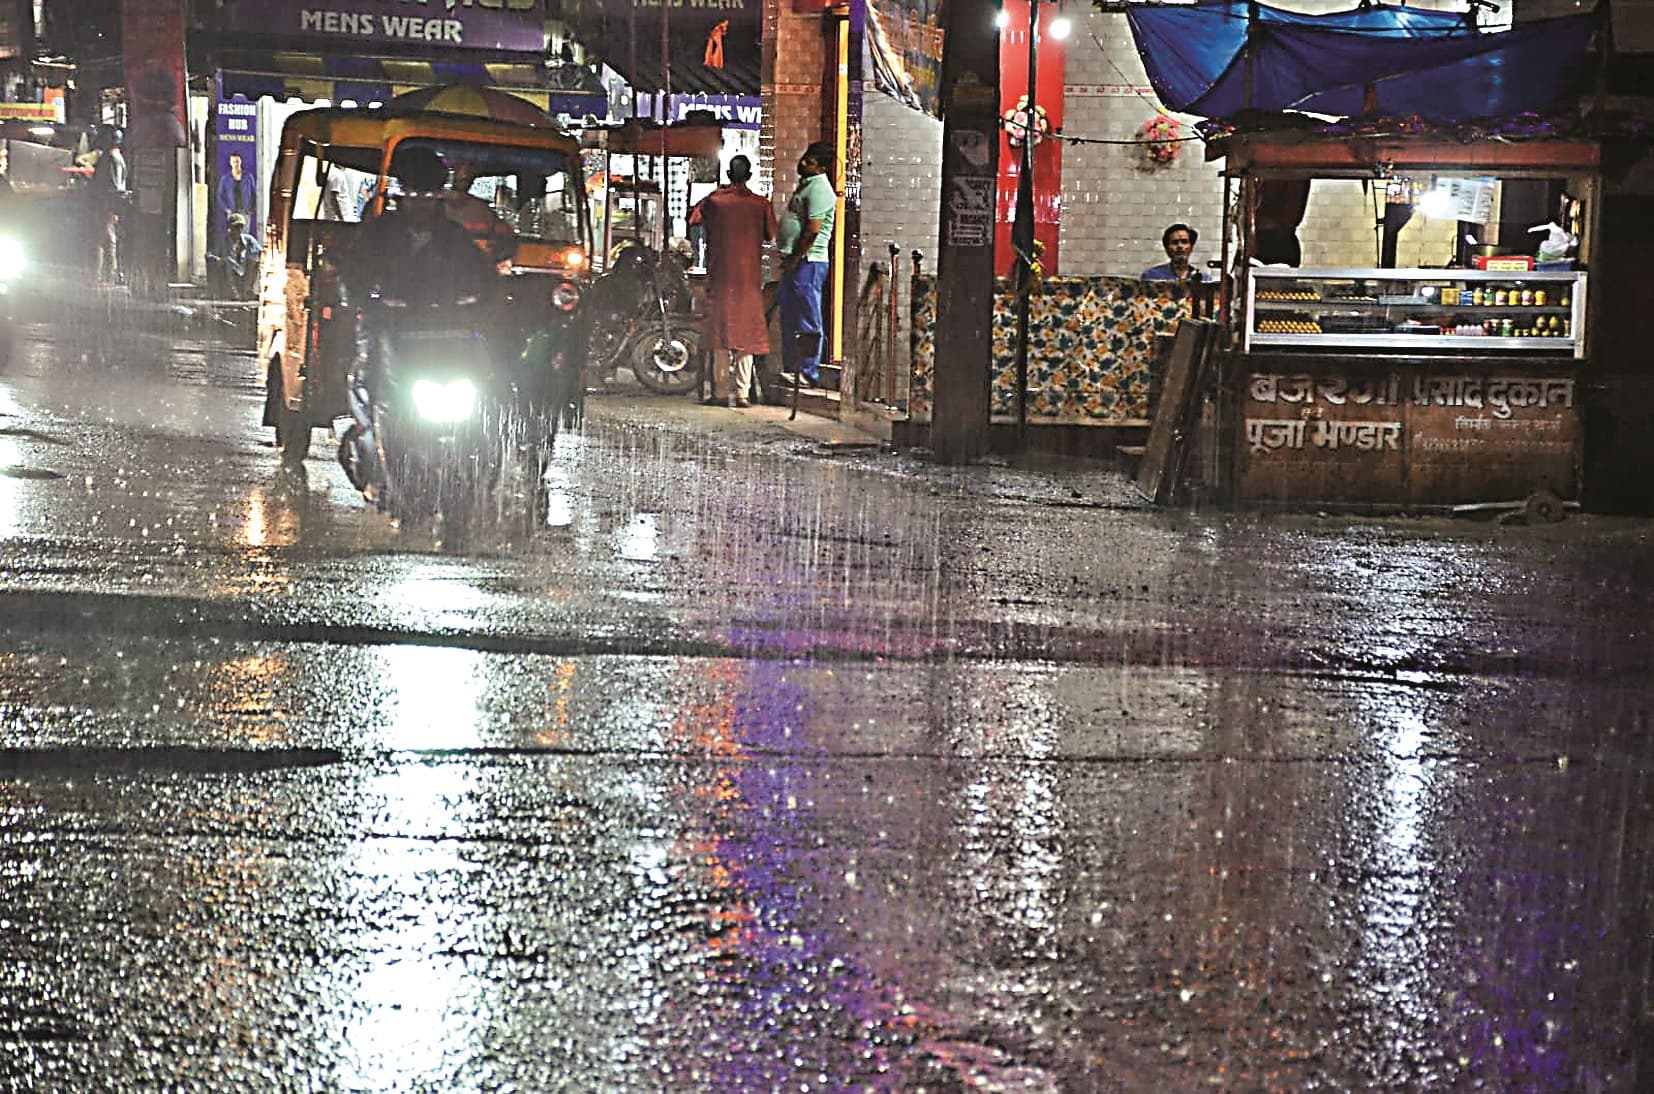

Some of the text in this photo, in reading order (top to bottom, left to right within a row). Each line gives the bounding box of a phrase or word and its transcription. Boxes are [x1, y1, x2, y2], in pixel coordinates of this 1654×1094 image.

[301, 9, 463, 43] MENS WEAR
[218, 103, 256, 116] FASHION
[1487, 377, 1575, 420] दुकान
[1245, 419, 1307, 457] पूजा
